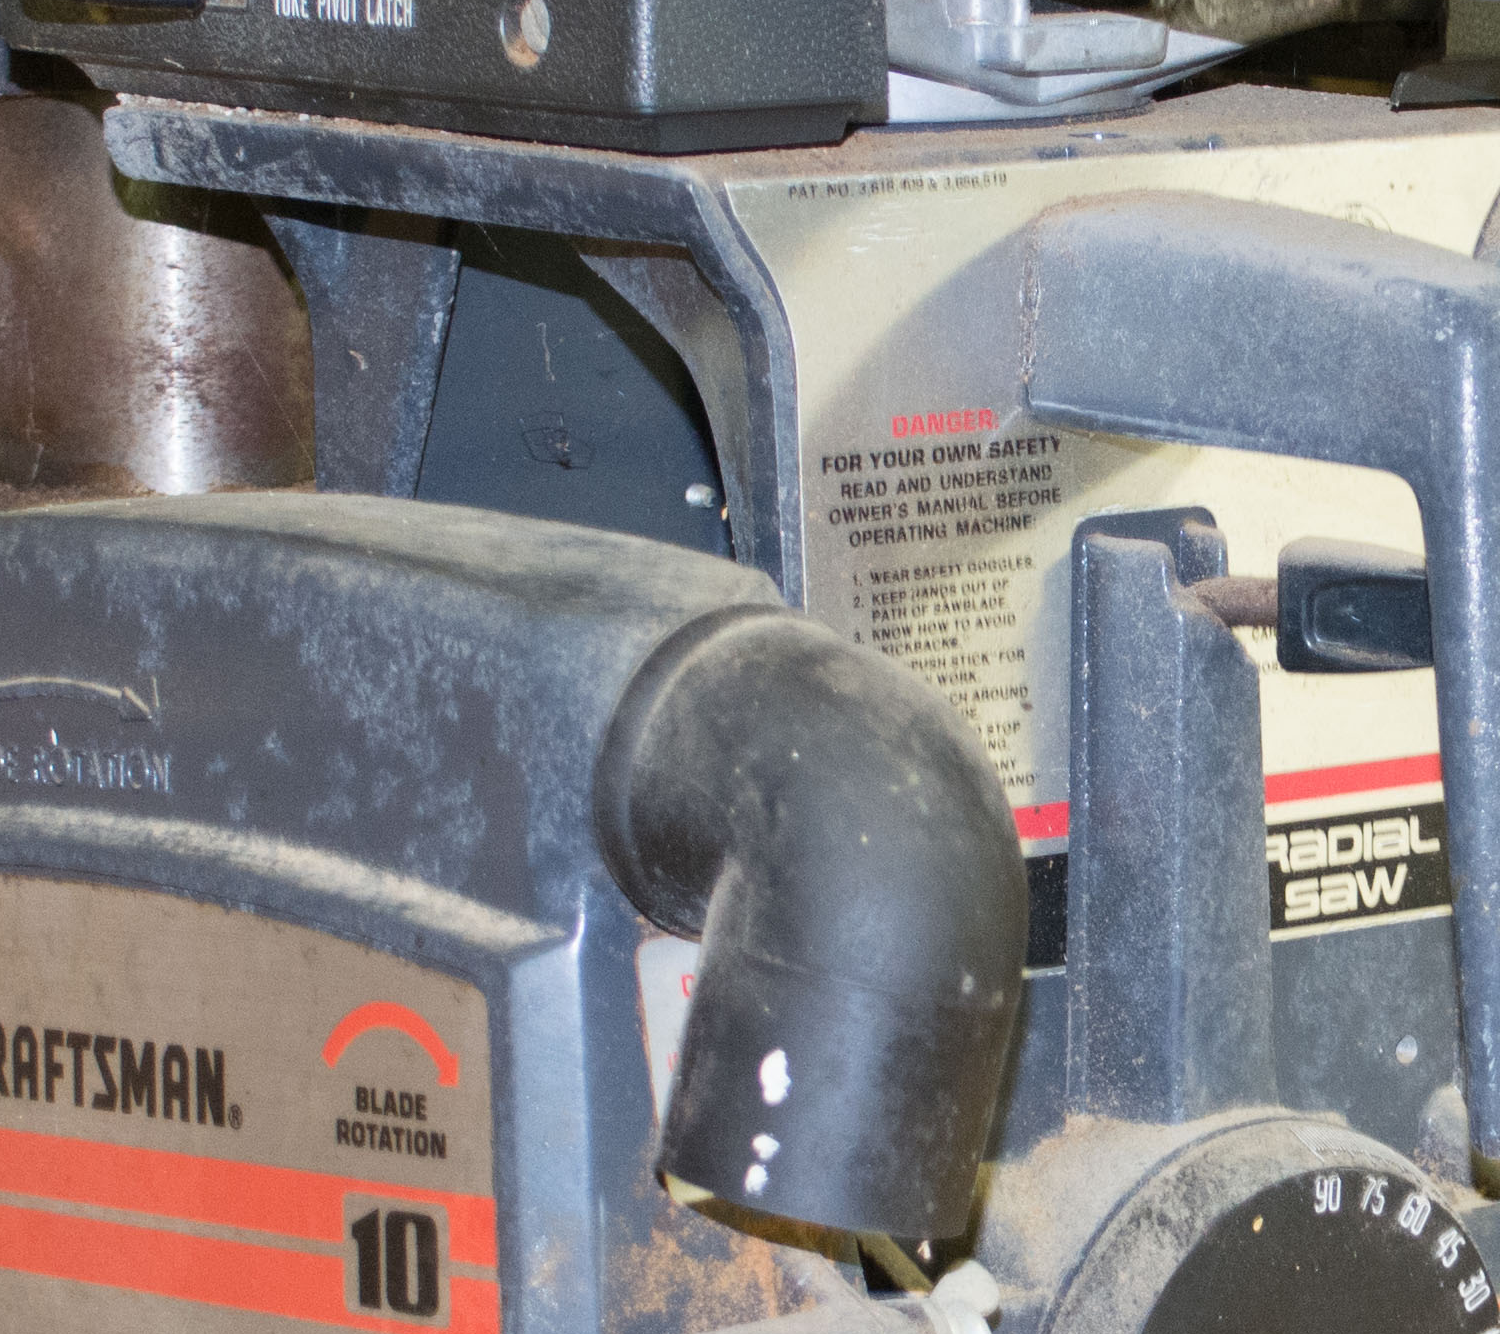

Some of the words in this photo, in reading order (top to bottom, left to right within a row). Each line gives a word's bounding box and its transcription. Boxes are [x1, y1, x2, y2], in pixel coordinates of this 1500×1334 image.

[892, 408, 999, 438] DANGER:
[822, 453, 862, 475] FOR
[869, 448, 924, 470] YOUR
[932, 442, 982, 464] OWN
[989, 435, 1061, 459] SAFETY
[841, 481, 887, 499] READ
[896, 476, 931, 494] AND
[940, 465, 1053, 490] UNDERSTAND
[829, 503, 909, 526] OWNER'S
[917, 496, 988, 517] MANUAL
[996, 488, 1062, 510] BEFORE
[849, 523, 947, 548] OPERATING
[870, 569, 910, 585] WEAR
[914, 563, 962, 581] SAFETY
[853, 596, 864, 609] 2.
[871, 590, 907, 607] KEEP
[911, 584, 957, 602] HANDS
[961, 581, 987, 596] OUT
[854, 630, 865, 644] 3.
[871, 625, 912, 643] KNOW
[918, 620, 949, 636] HOW
[955, 618, 971, 633] TO
[975, 613, 1017, 629] AVOID
[871, 606, 908, 624] PATH
[911, 603, 929, 618] OF
[999, 648, 1026, 663] FOR
[972, 685, 1030, 702] AROUND
[986, 721, 1022, 736] STOP
[355, 1085, 428, 1121] BLADE
[336, 1118, 447, 1160] ROTATION
[1314, 1174, 1341, 1214] 90
[1360, 1175, 1389, 1216] 75
[1399, 1192, 1431, 1236] 60
[351, 1207, 440, 1318] 10
[1434, 1228, 1466, 1268] 45
[1458, 1268, 1491, 1313] 30
